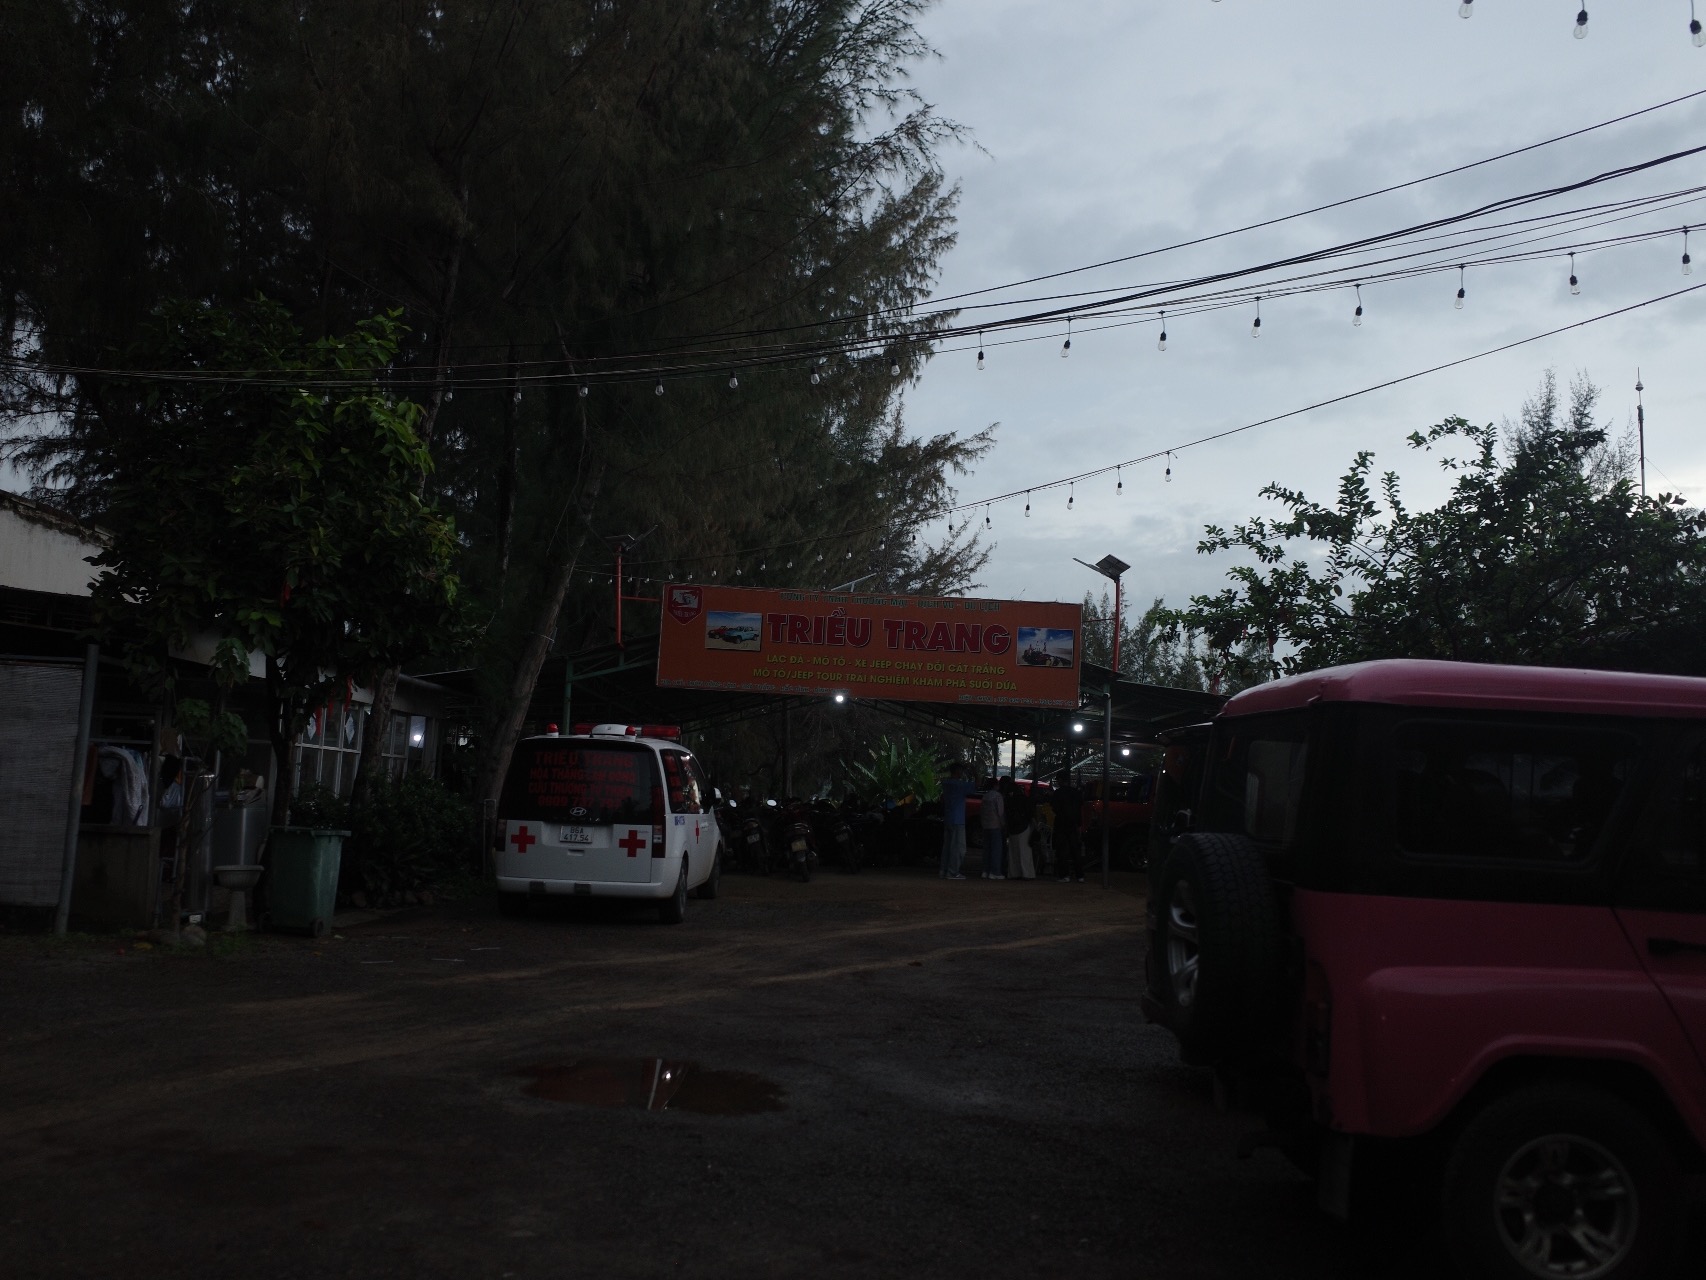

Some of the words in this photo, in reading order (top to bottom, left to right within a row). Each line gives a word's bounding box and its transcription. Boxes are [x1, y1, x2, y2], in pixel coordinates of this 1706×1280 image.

[883, 618, 1011, 655] TRANG
[855, 659, 867, 668] XE
[870, 659, 892, 669] JEEP
[816, 671, 843, 682] TOUR
